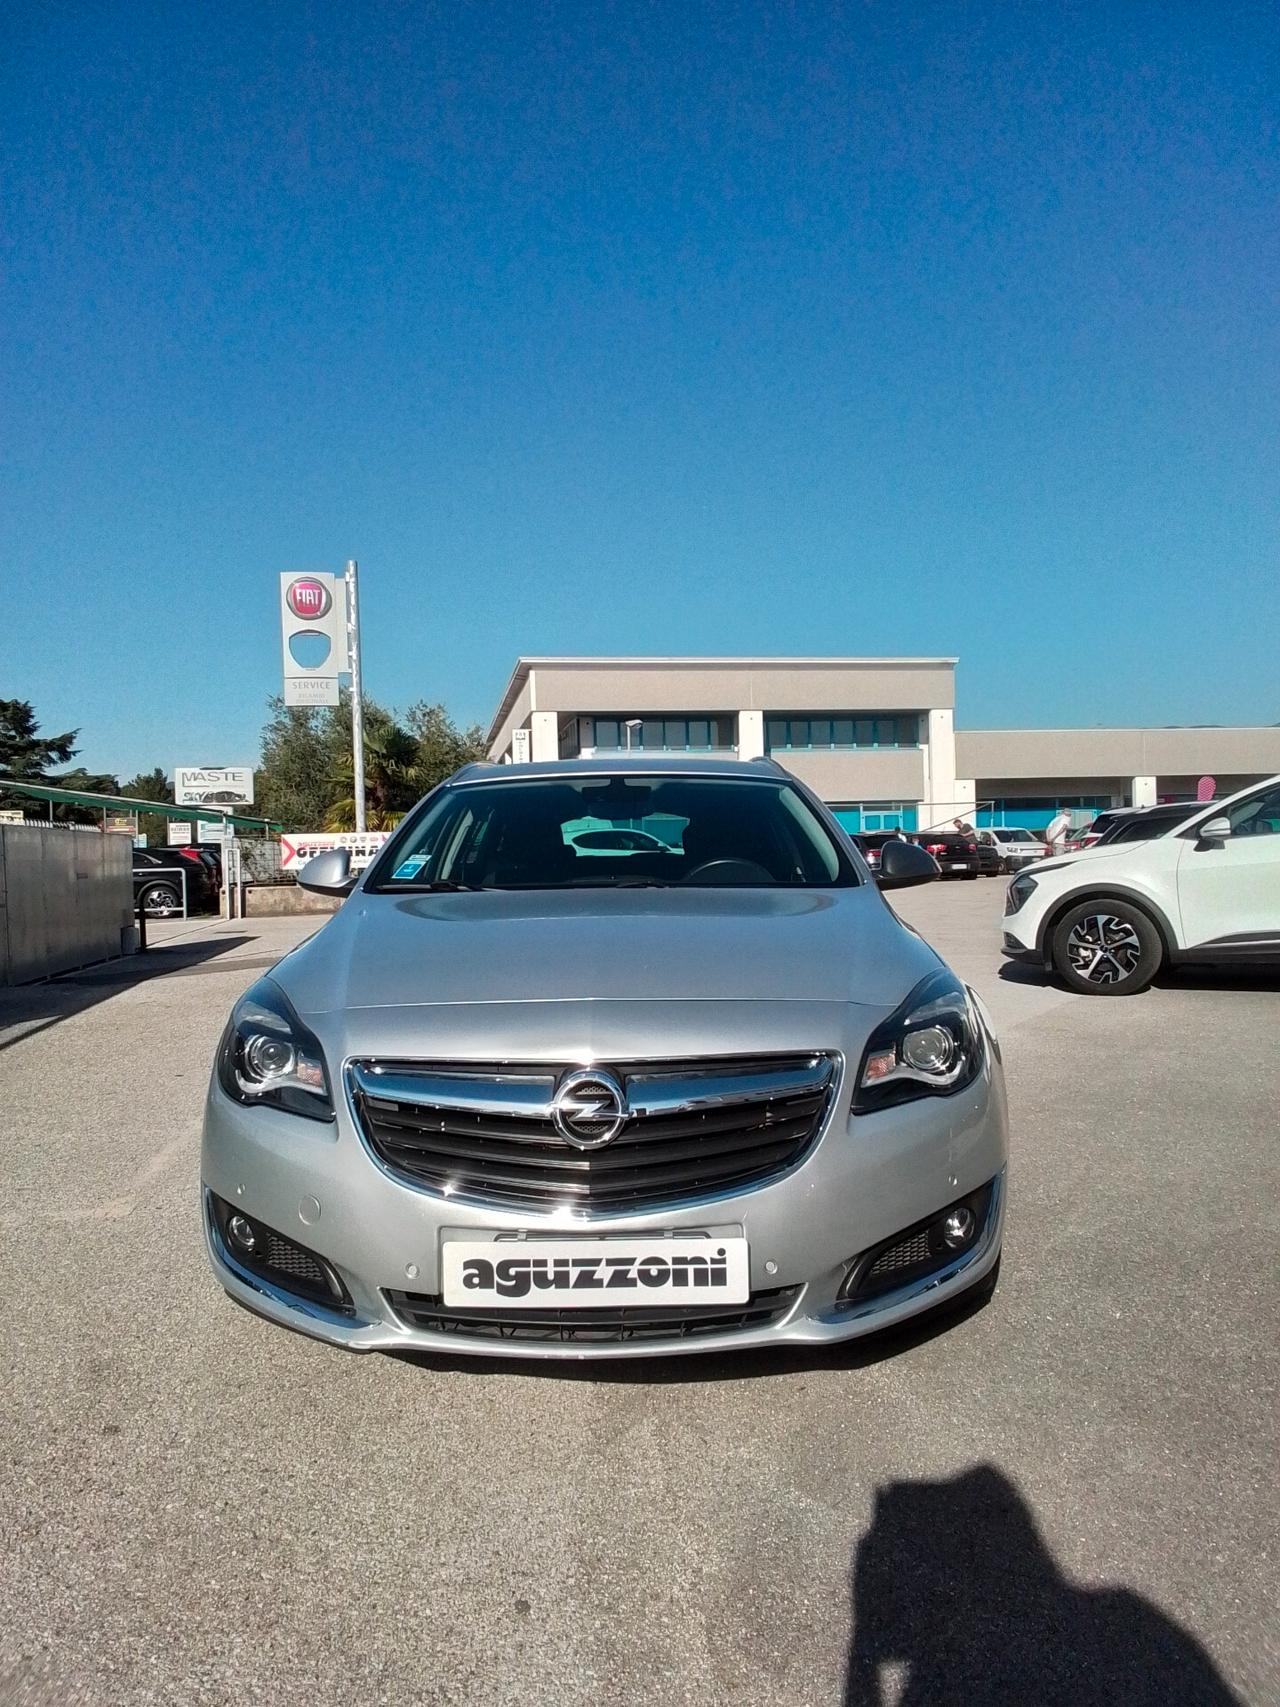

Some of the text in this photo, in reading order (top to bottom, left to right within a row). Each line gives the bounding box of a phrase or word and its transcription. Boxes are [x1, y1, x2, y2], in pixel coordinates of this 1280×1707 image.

[295, 588, 321, 605] FIAT
[292, 681, 331, 690] SERVICE
[462, 1247, 728, 1298] aguzzoni
